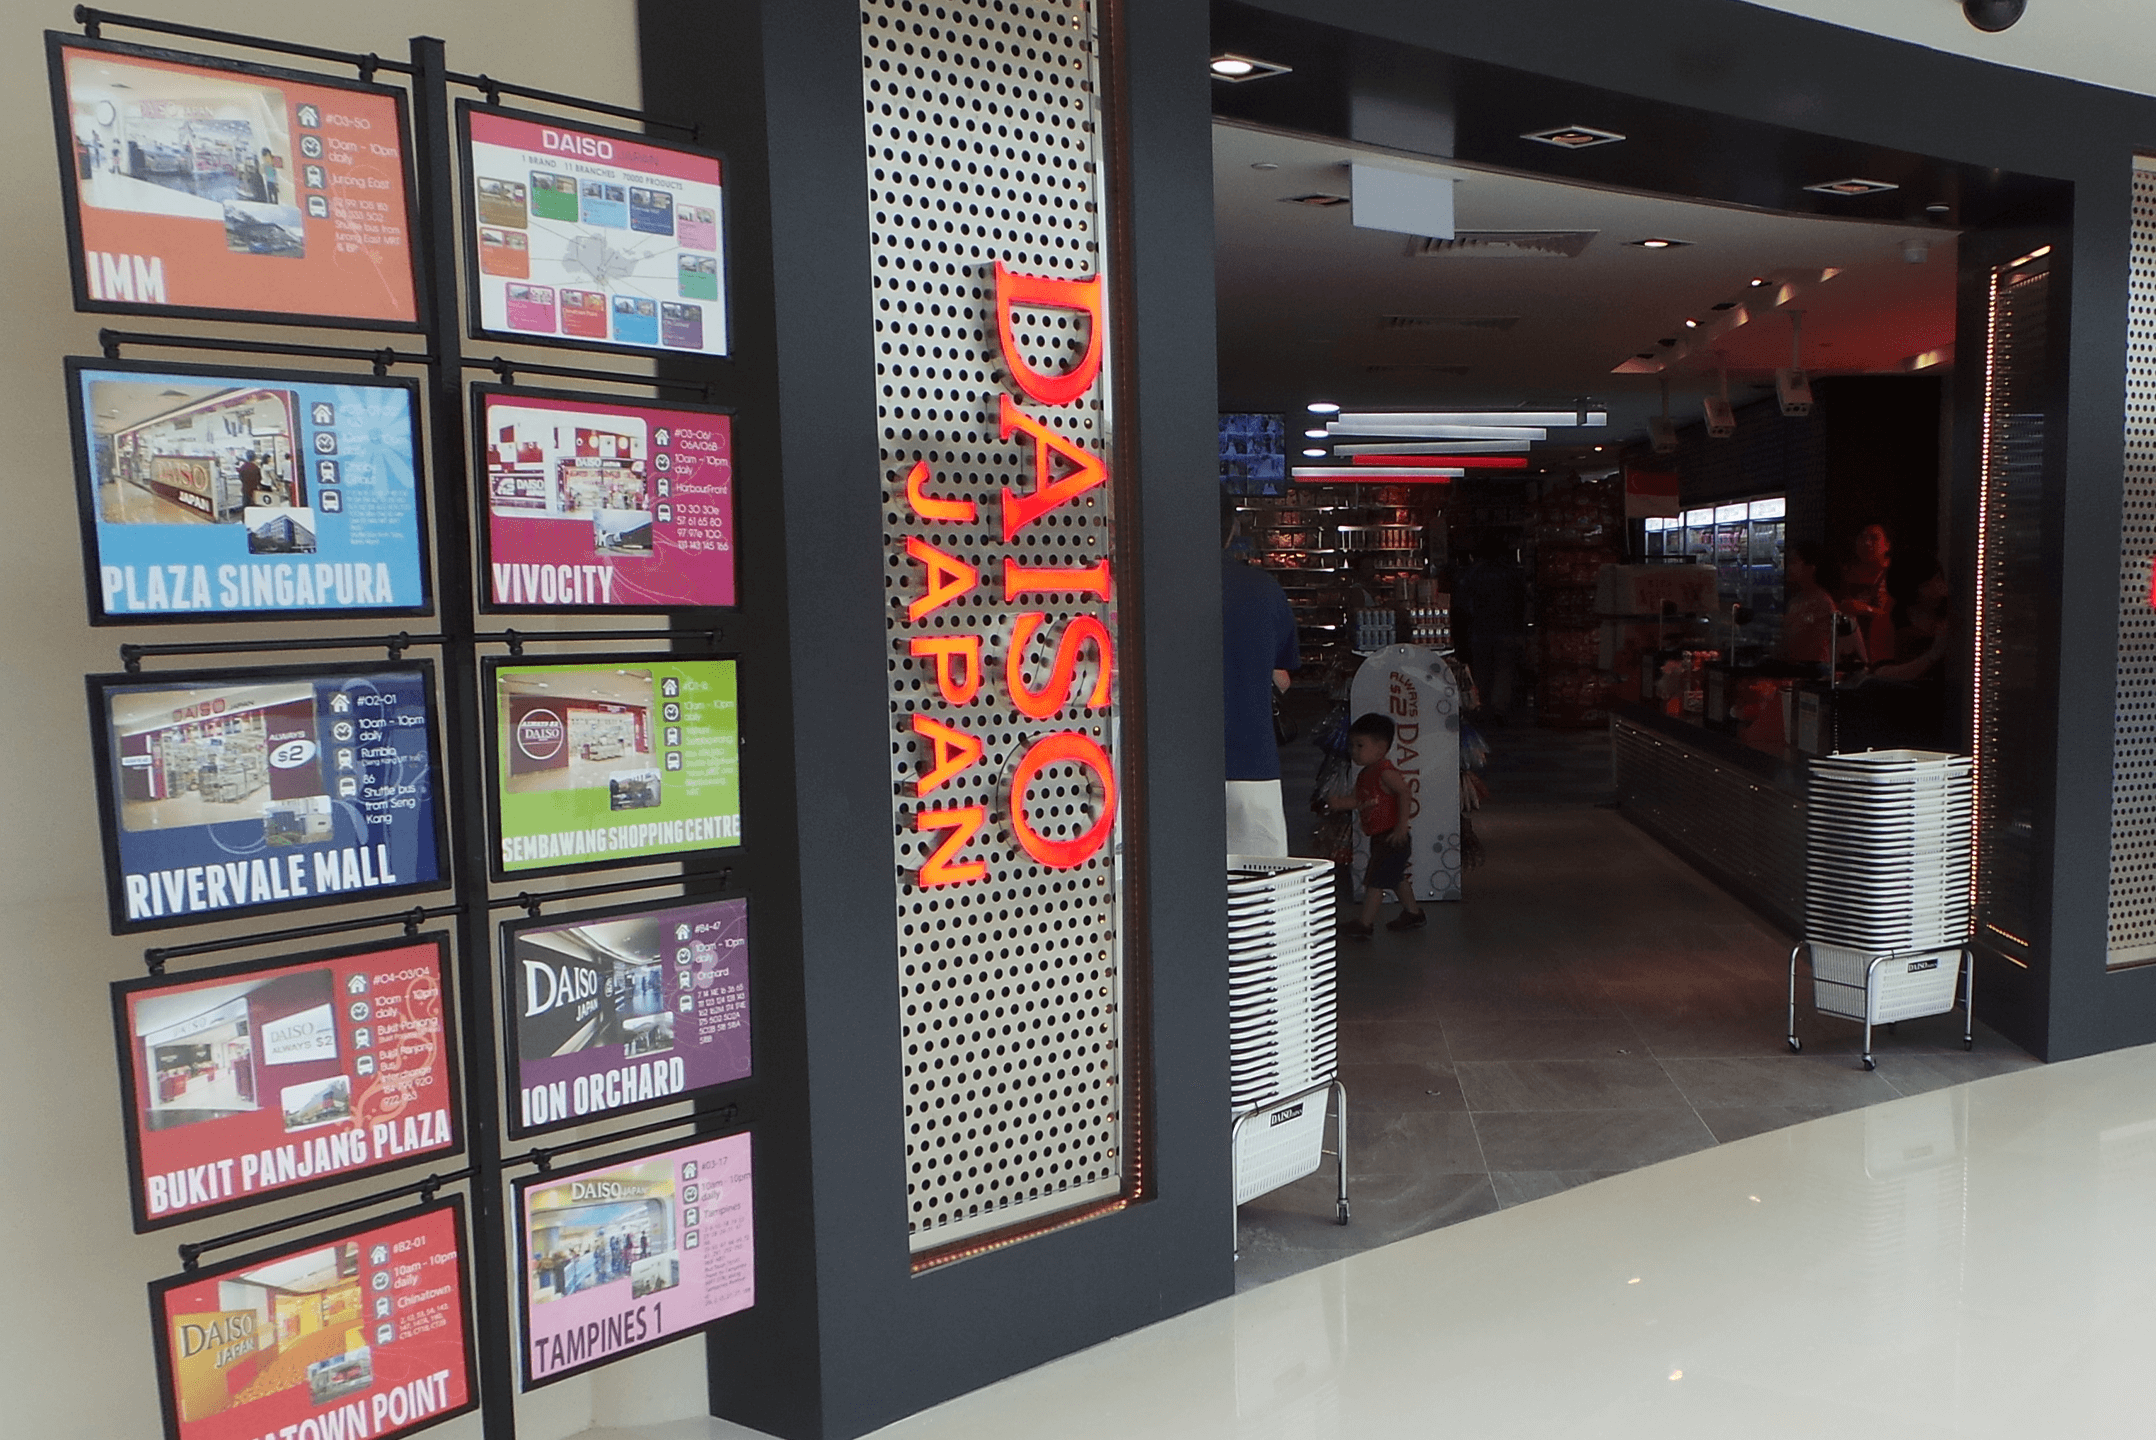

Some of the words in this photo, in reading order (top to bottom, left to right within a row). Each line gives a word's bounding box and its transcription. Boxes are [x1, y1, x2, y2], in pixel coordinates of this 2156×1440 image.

[326, 112, 372, 131] #03-50
[327, 138, 358, 152] 10am
[369, 143, 399, 158] 10pm
[541, 128, 614, 160] DAISO
[528, 156, 557, 168] BRAND
[564, 162, 574, 172] 11
[575, 163, 616, 180] BRANCHES
[622, 172, 644, 185] 70000
[645, 175, 683, 191] PRODUCTS
[367, 177, 390, 190] East
[88, 250, 166, 303] IMM
[674, 453, 697, 464] 10am
[706, 456, 728, 467] 10pm
[674, 465, 694, 476] daily
[178, 490, 211, 512] JAPAN
[676, 503, 687, 514] 10
[687, 504, 701, 515] 30
[687, 517, 697, 526] 61
[697, 517, 709, 527] 65
[709, 517, 722, 528] 80
[704, 529, 722, 539] 100
[993, 260, 1116, 870] DAISO
[100, 564, 212, 613] PLAZA
[217, 561, 394, 609] SINGAPURA
[492, 563, 614, 604] VIVOCITY
[905, 461, 988, 888] JAPAN
[357, 693, 397, 707] #02-01
[1389, 670, 1419, 718] ALWAYS
[1389, 684, 1408, 717] $2
[172, 698, 226, 723] DAISO
[358, 718, 387, 729] 10am
[397, 715, 425, 728] 10pm
[268, 730, 306, 742] ALWAYS
[360, 729, 382, 742] daily
[524, 728, 560, 739] DAISO
[361, 745, 397, 758] Rumbia
[363, 773, 376, 785] 86
[1396, 722, 1421, 820] DAISO
[364, 785, 396, 798] Shuttle
[398, 784, 416, 795] bus
[365, 801, 388, 811] from
[390, 797, 416, 809] Seng
[366, 814, 393, 825] Kang
[502, 827, 608, 864] SEMBAWANG
[608, 819, 684, 852] SHOPPING
[684, 813, 740, 843] CENTRE
[125, 853, 308, 920] RIVERVALE
[313, 843, 396, 893] MALL
[725, 938, 744, 948] 10pm
[372, 966, 430, 986] #04-03/04
[697, 967, 729, 980] Orchard
[522, 958, 598, 1018] DAISO
[375, 995, 402, 1007] 10am
[575, 997, 598, 1022] JAPAN
[376, 1007, 398, 1019] daily
[270, 1021, 315, 1044] DAISO
[271, 1040, 313, 1055] ALWAYS
[315, 1035, 334, 1048] $2
[521, 1080, 567, 1128] ION
[573, 1055, 685, 1116] ORCHARD
[148, 1158, 233, 1214] BUKIT
[241, 1128, 367, 1191] PANJANG
[373, 1108, 452, 1159] PLAZA
[702, 1156, 728, 1170] #03-17
[571, 1181, 621, 1200] DAISO
[702, 1180, 723, 1190] 10am
[731, 1173, 751, 1183] 10pm
[701, 1190, 720, 1201] daily
[703, 1203, 741, 1218] Tampines
[393, 1235, 426, 1254] #B2-01
[394, 1262, 421, 1277] 10am
[430, 1251, 457, 1266] 10pm
[394, 1274, 418, 1289] daily
[397, 1284, 451, 1308] Chinatown
[179, 1311, 256, 1360] DAISO
[534, 1304, 648, 1374] TAMPINES
[654, 1300, 662, 1335] 1
[213, 1338, 256, 1370] JAPAN
[253, 1399, 368, 1440] TOWN
[371, 1369, 450, 1434] POINT
